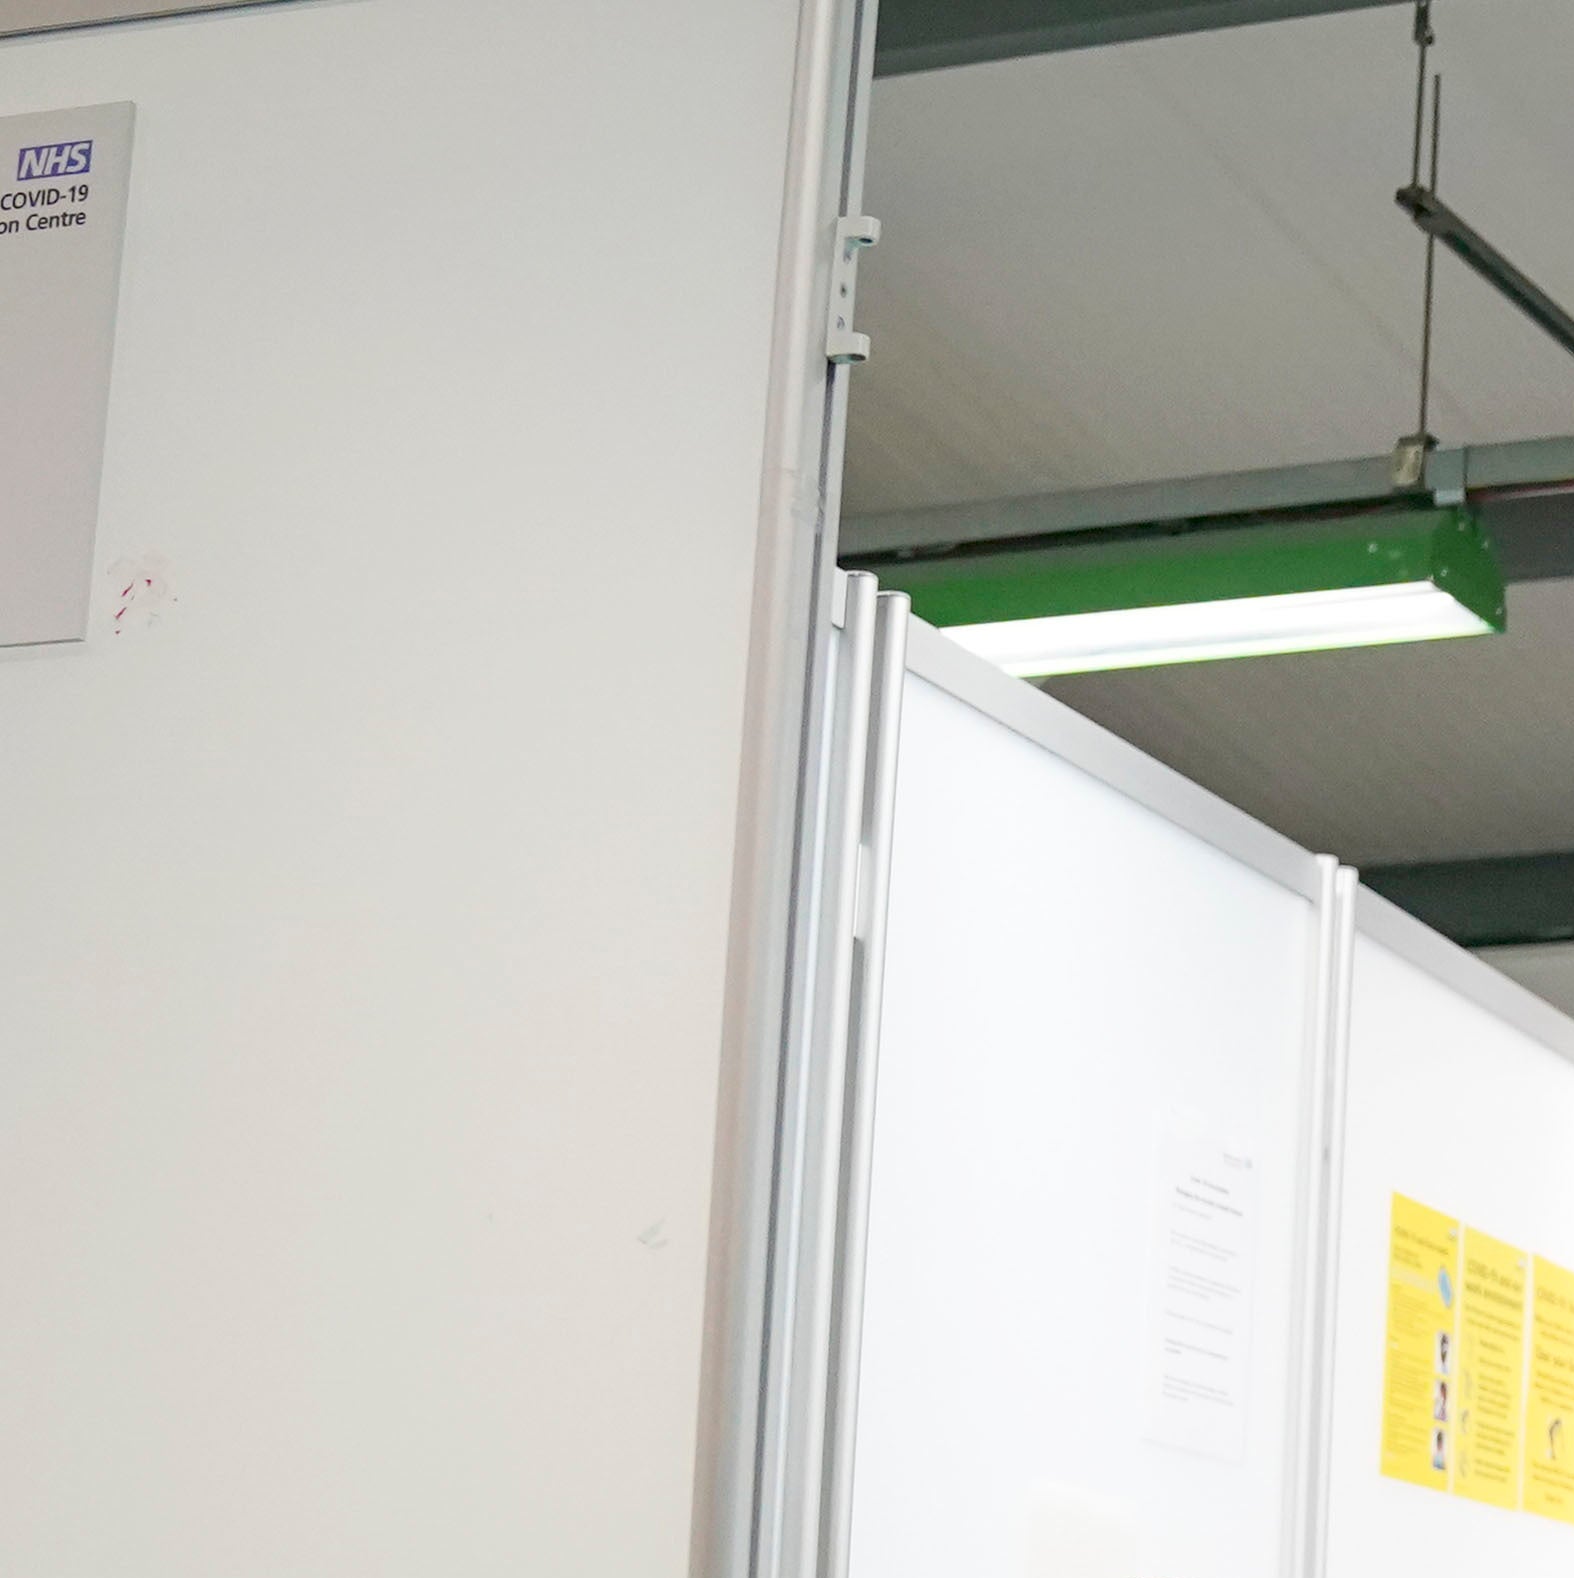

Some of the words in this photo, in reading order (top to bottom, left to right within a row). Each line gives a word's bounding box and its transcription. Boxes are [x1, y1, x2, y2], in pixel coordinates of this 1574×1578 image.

[18, 141, 92, 180] NHS
[0, 184, 89, 210] COVID-19
[26, 211, 86, 231] Centre
